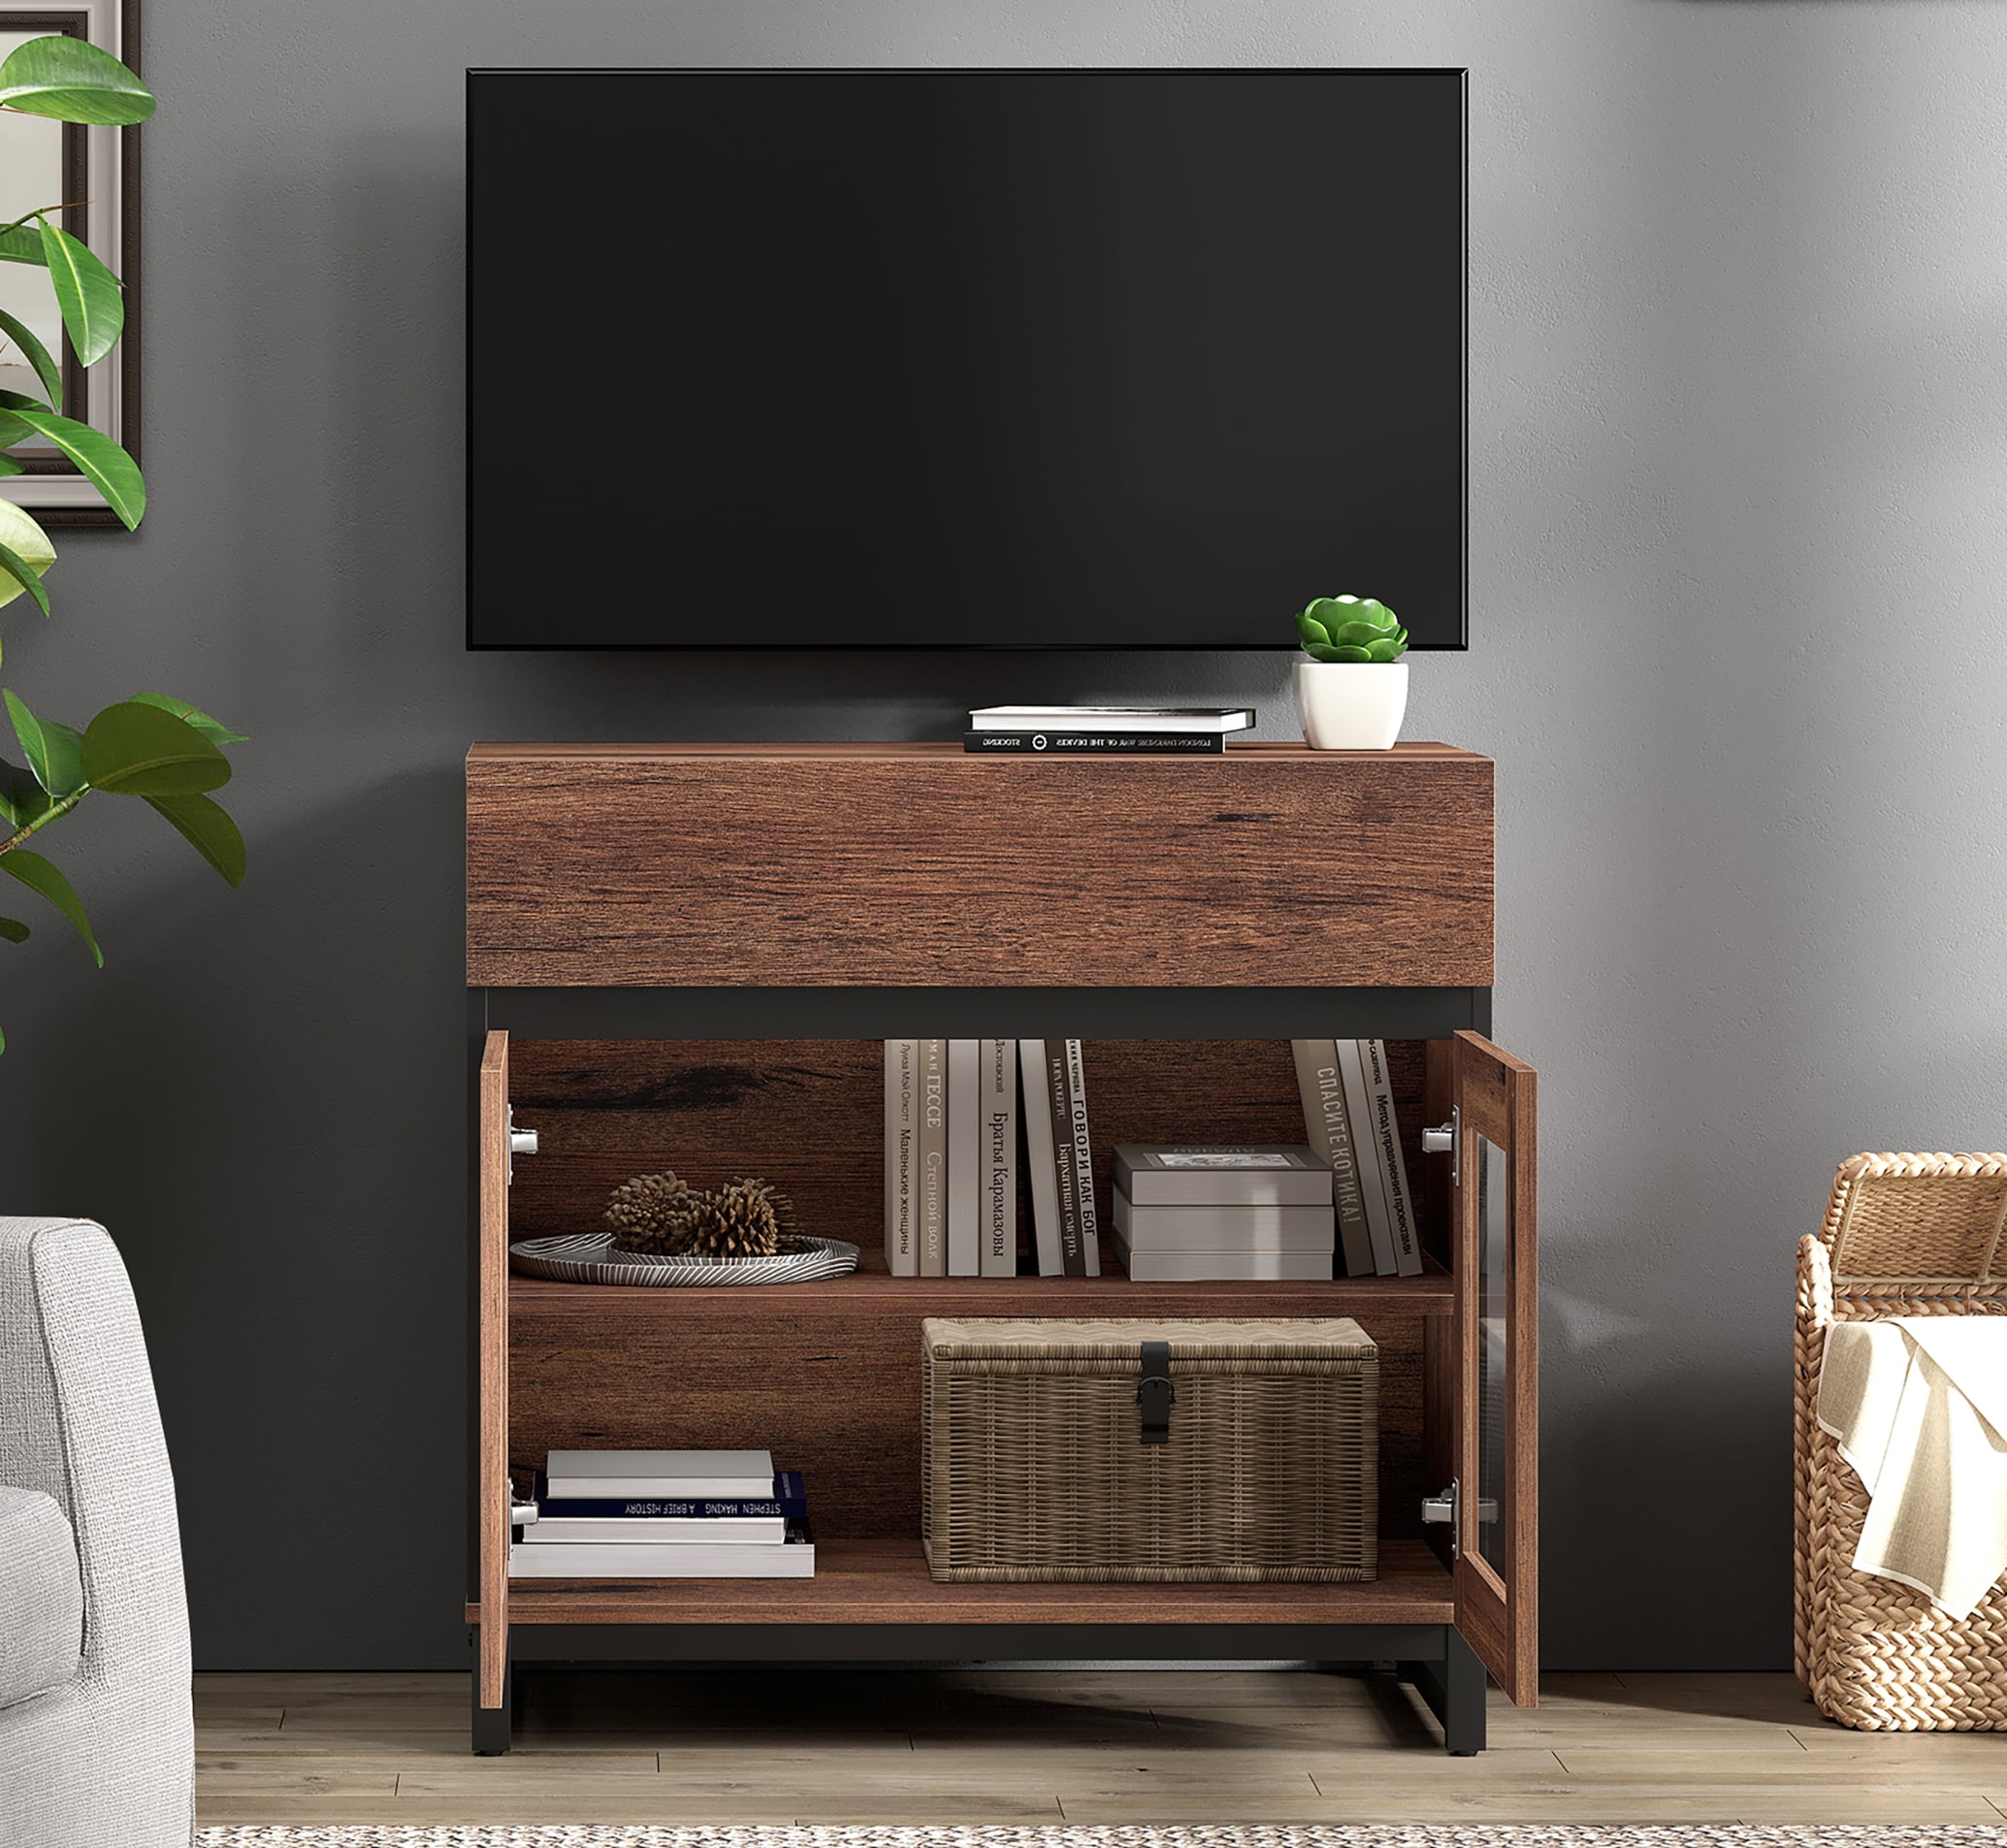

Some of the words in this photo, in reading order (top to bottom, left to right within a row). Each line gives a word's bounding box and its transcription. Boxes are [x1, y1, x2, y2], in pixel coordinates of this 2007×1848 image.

[900, 1044, 911, 1069] Луиза
[994, 1040, 1005, 1093] Достоевский
[901, 1091, 911, 1121] Олкотт
[927, 1075, 941, 1128] ГЕССЕ
[1054, 1082, 1066, 1119] РОБЕРТС
[988, 1113, 1008, 1163] Братья
[1073, 1100, 1089, 1169] ГОВОРИ
[1317, 1067, 1347, 1144] СПАСИТЕ
[1332, 1148, 1361, 1222] КОТИКА!
[900, 1129, 911, 1194] Маленькие
[1057, 1144, 1073, 1211] Бархатная
[1376, 1094, 1390, 1129] Метод
[1393, 1196, 1412, 1255] проектами
[927, 1151, 942, 1220] Степной
[1080, 1177, 1092, 1203] КАК
[899, 1197, 909, 1255] женщины
[988, 1168, 1008, 1256] Карамазовы
[1083, 1211, 1095, 1236] БОГ
[928, 1225, 938, 1258] волк
[1064, 1213, 1077, 1257] смерть
[625, 1504, 662, 1514] HISTORY
[664, 1504, 687, 1514] BRIEF
[689, 1504, 696, 1514] A
[705, 1504, 737, 1514] HAKING
[743, 1504, 781, 1514] STEPHEN
